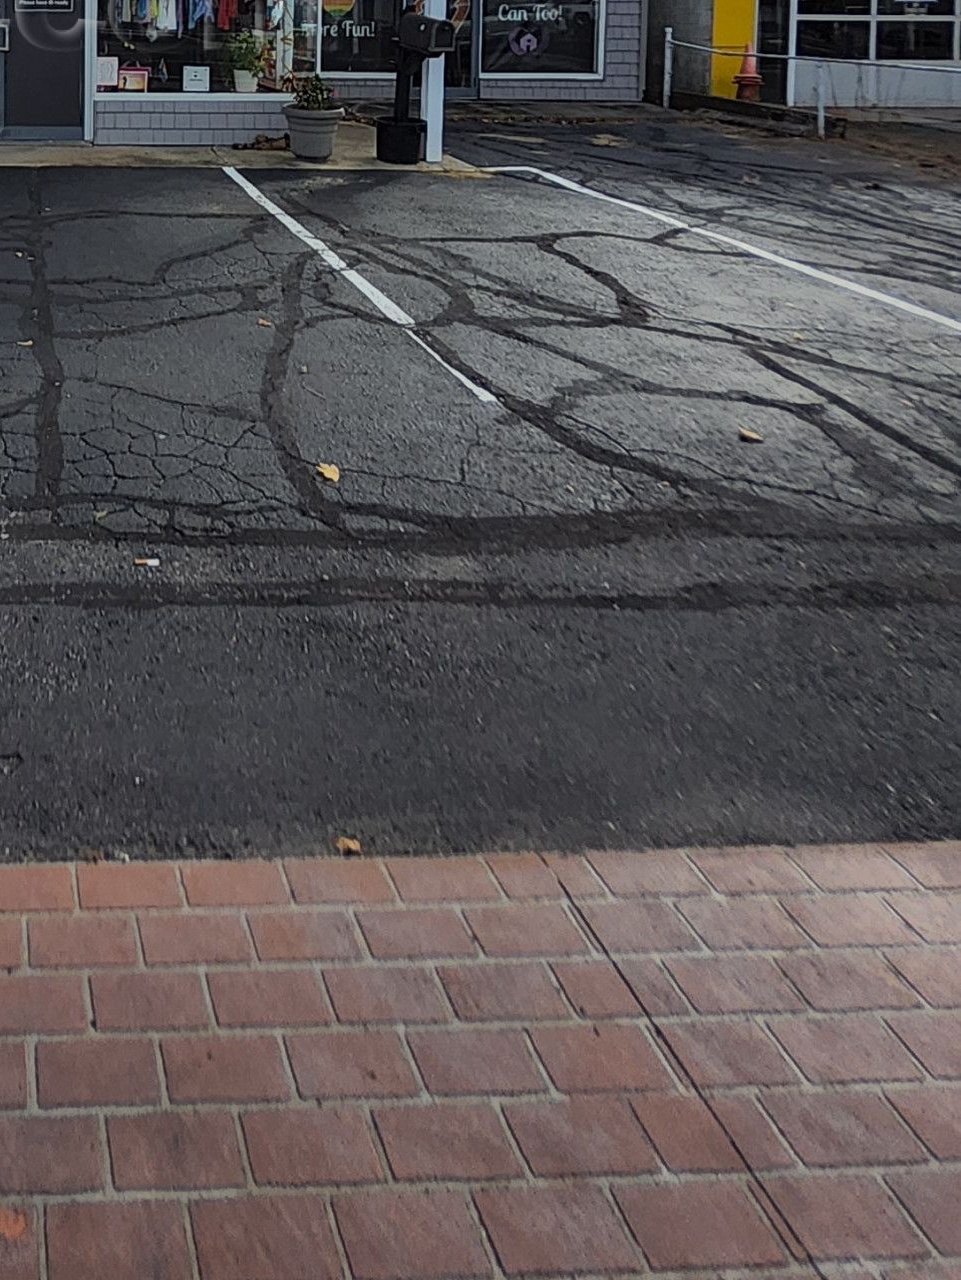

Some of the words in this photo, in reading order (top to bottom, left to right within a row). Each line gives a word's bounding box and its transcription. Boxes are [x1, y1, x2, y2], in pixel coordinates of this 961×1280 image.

[498, 4, 528, 20] Can
[532, 4, 563, 20] Too!
[342, 20, 375, 37] Fun!
